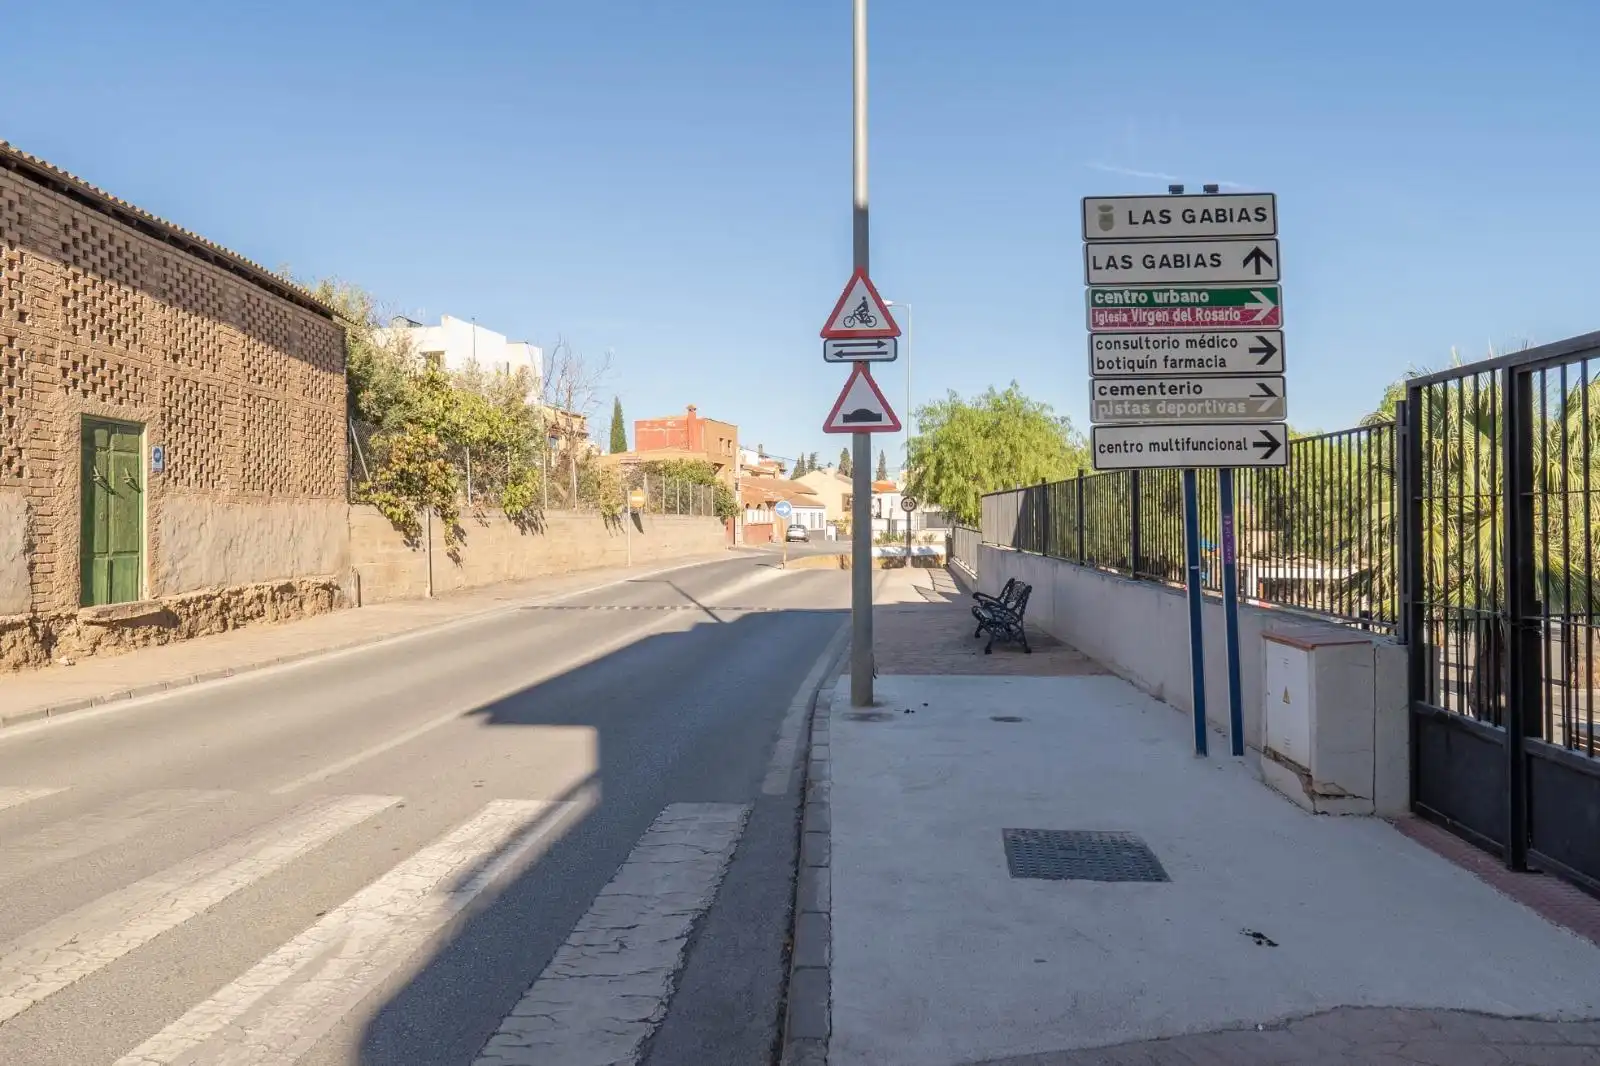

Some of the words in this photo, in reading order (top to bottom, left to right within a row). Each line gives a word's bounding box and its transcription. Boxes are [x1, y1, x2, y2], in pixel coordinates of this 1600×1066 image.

[1128, 210, 1172, 225] LAS
[1182, 207, 1268, 224] GABIAS
[1092, 255, 1133, 270] LAS
[1142, 253, 1222, 269] GABIAS
[1094, 290, 1148, 304] centro
[1153, 290, 1209, 304] urbano
[1131, 309, 1169, 324] Virgen
[1174, 308, 1192, 321] del
[1196, 308, 1240, 321] Rosario
[1096, 336, 1180, 350] consultorio
[1185, 335, 1238, 348] médico
[1097, 355, 1157, 372] botiquín
[1163, 355, 1226, 369] farmacia
[1098, 381, 1203, 396] cementerio
[1098, 402, 1150, 418] pistas
[1156, 400, 1246, 417] deportivas
[1099, 441, 1143, 454] centro
[1149, 437, 1248, 453] multifuncional
